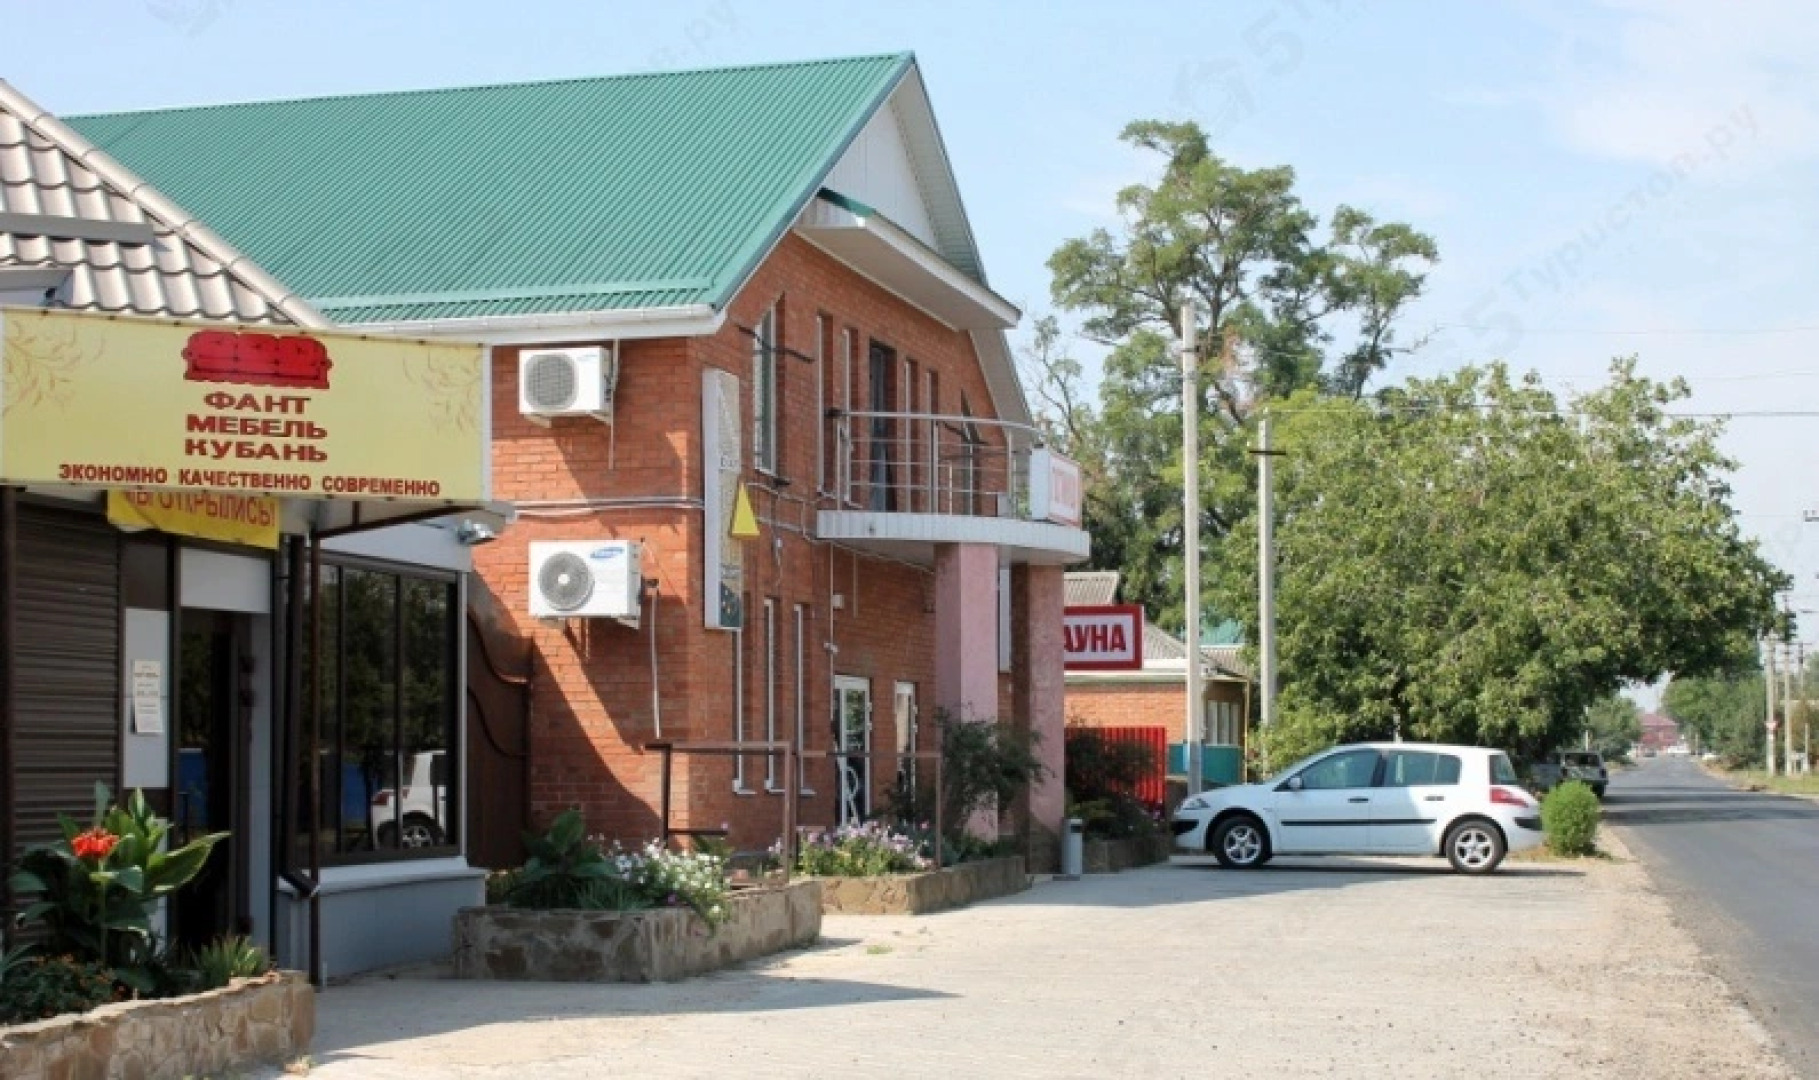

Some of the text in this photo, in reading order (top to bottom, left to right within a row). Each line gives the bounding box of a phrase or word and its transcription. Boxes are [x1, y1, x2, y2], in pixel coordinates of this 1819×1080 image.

[203, 392, 313, 415] ФАНТ
[186, 414, 328, 439] МЕБЕЛЬ
[185, 438, 328, 463] КУБАНЬ
[59, 463, 441, 496] ЭКОНОМНО КАЧЕСТВЕННО СОВРЕМЕННО
